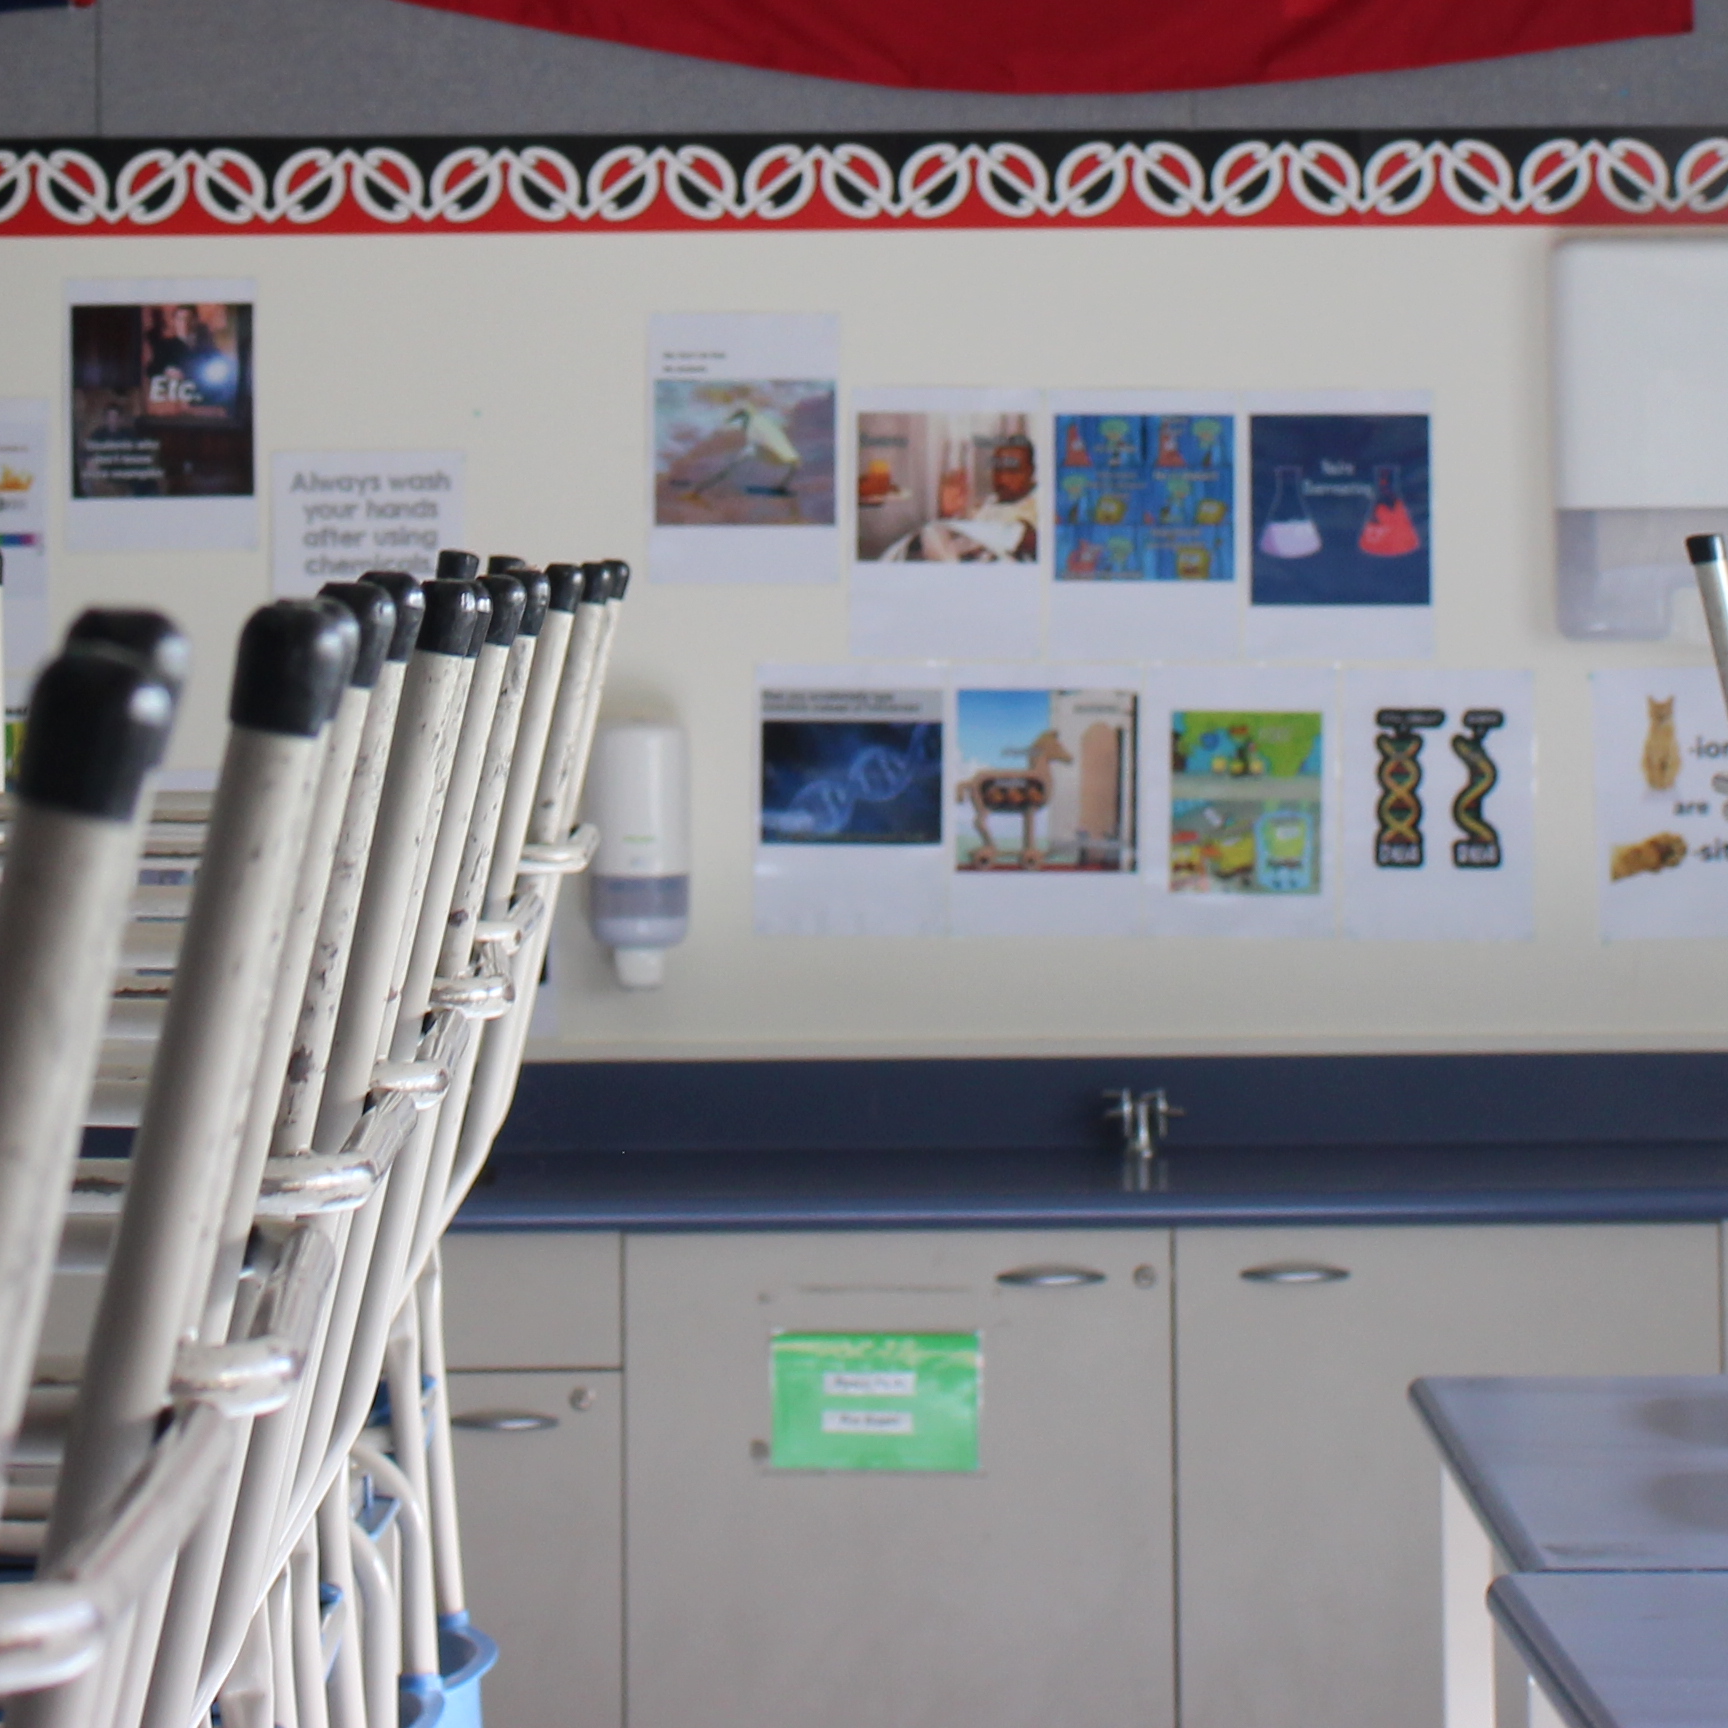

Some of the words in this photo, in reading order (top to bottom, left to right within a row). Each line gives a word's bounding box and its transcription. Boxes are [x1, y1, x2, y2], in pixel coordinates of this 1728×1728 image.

[289, 471, 381, 496] Always
[387, 470, 452, 491] wash
[303, 502, 358, 524] your
[366, 499, 438, 518] hands
[303, 526, 366, 547] after
[374, 526, 438, 549] using
[304, 553, 435, 575] chemicals
[1674, 801, 1710, 816] are
